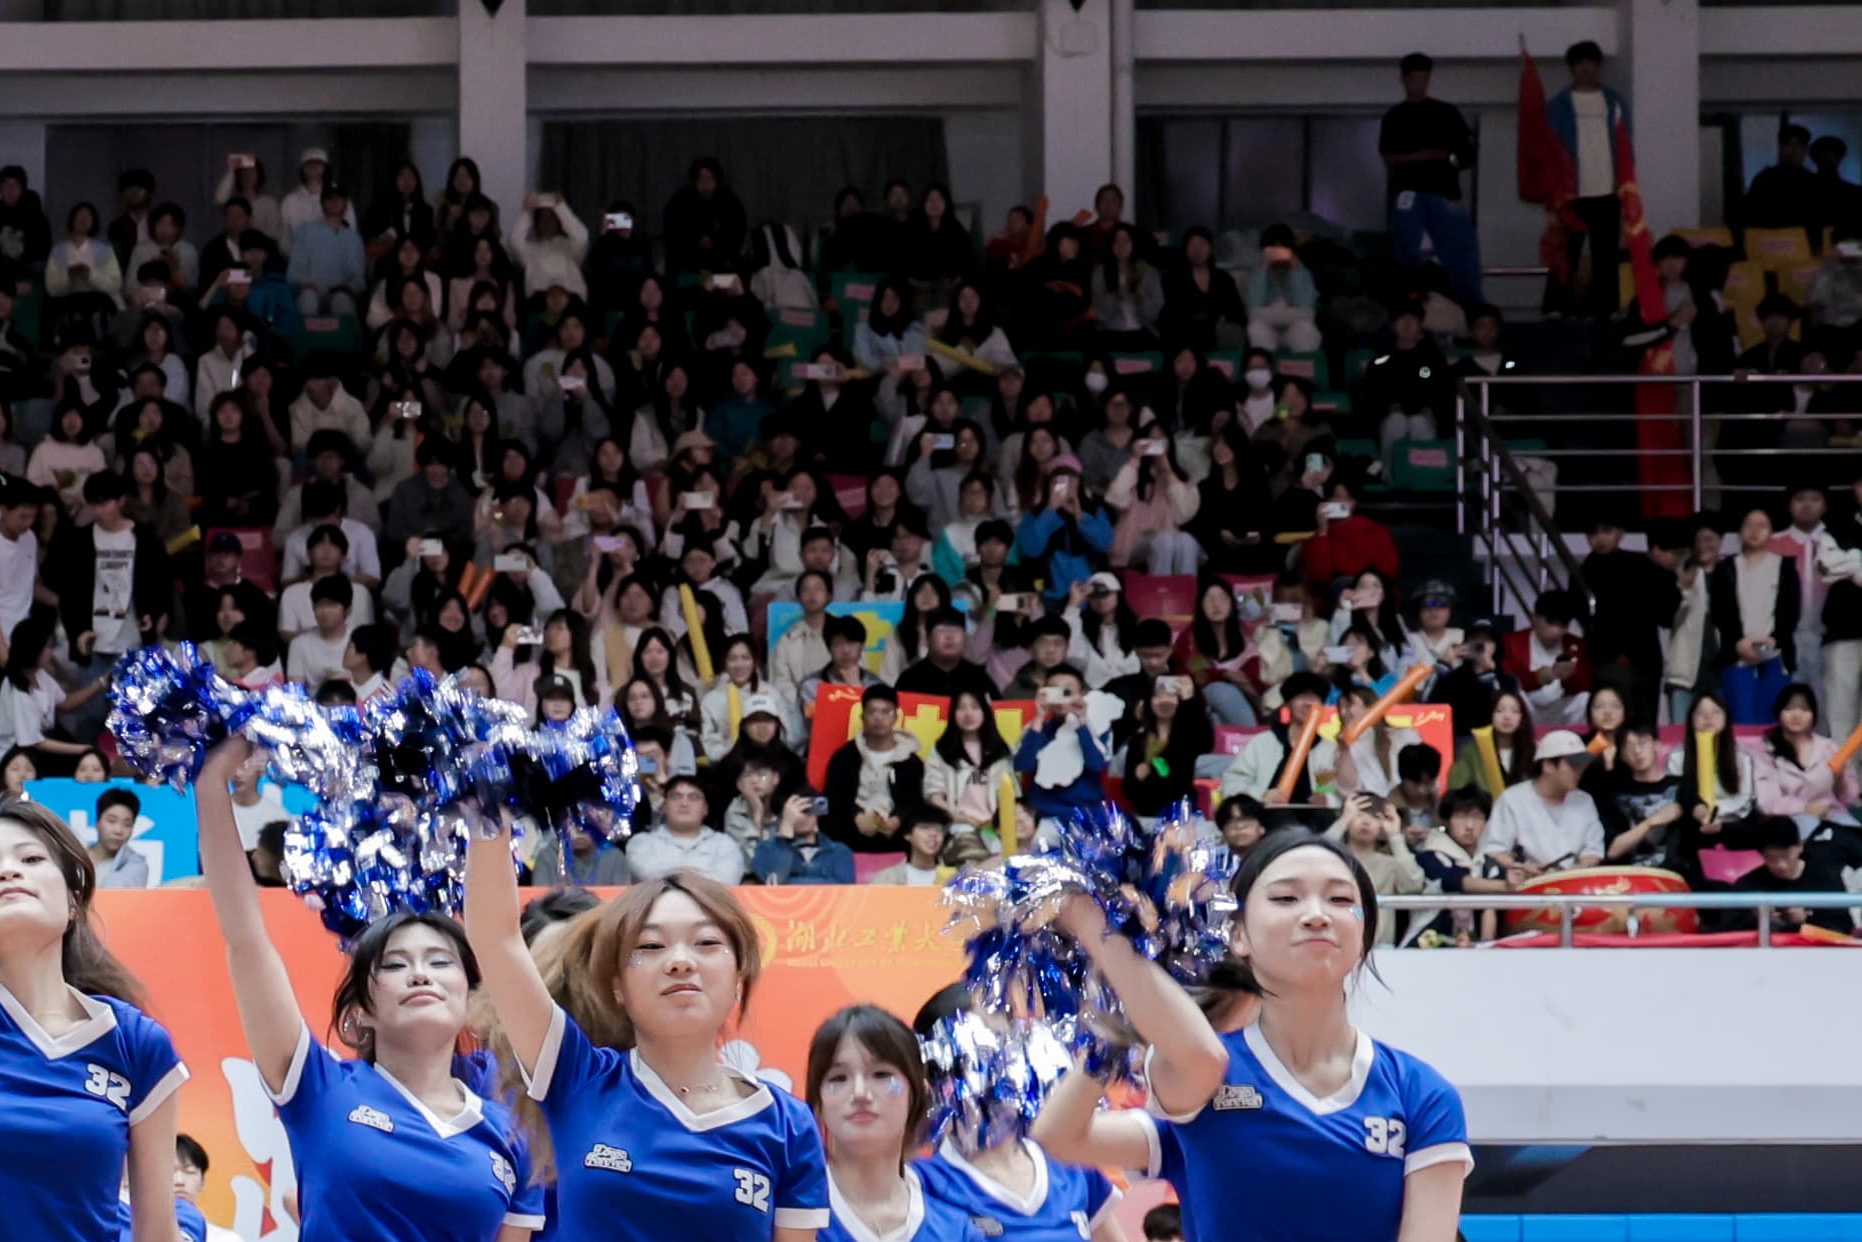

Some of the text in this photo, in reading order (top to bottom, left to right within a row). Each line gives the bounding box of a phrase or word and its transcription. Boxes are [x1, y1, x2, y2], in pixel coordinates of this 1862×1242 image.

[85, 1063, 131, 1111] 32
[1363, 1116, 1404, 1158] 32
[488, 1150, 516, 1195] 32
[733, 1168, 770, 1213] 32
